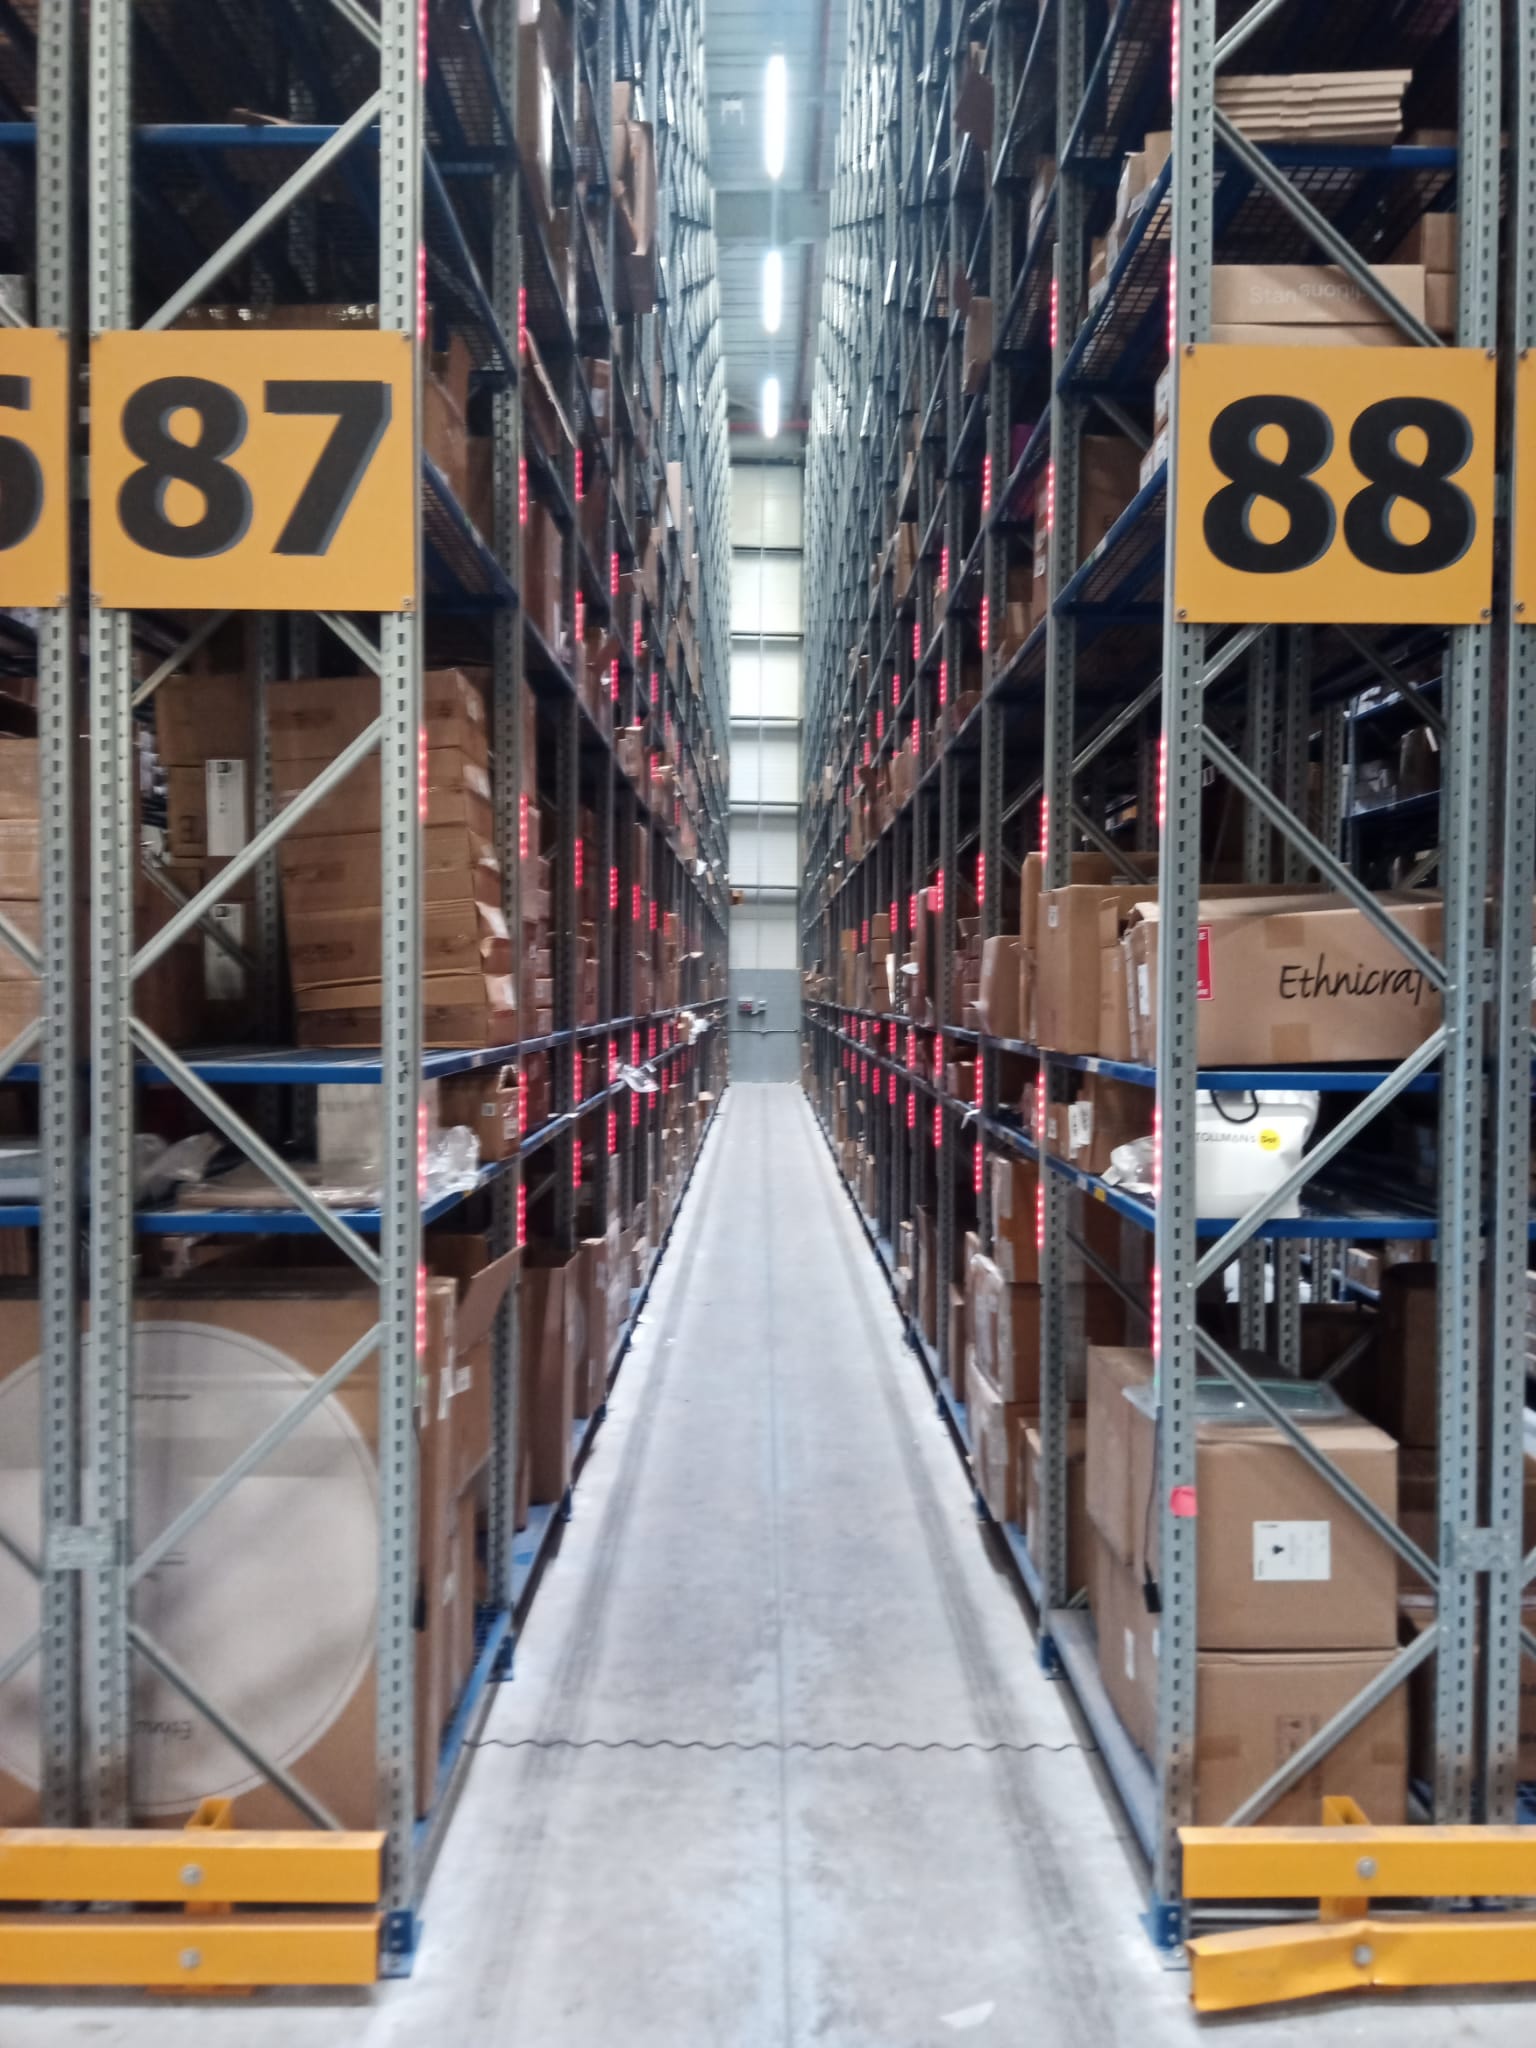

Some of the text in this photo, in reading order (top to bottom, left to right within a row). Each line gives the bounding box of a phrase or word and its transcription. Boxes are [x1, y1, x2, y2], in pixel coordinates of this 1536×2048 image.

[116, 376, 392, 558] 87
[1203, 394, 1476, 574] 88
[1278, 951, 1440, 1006] Ethnicraf
